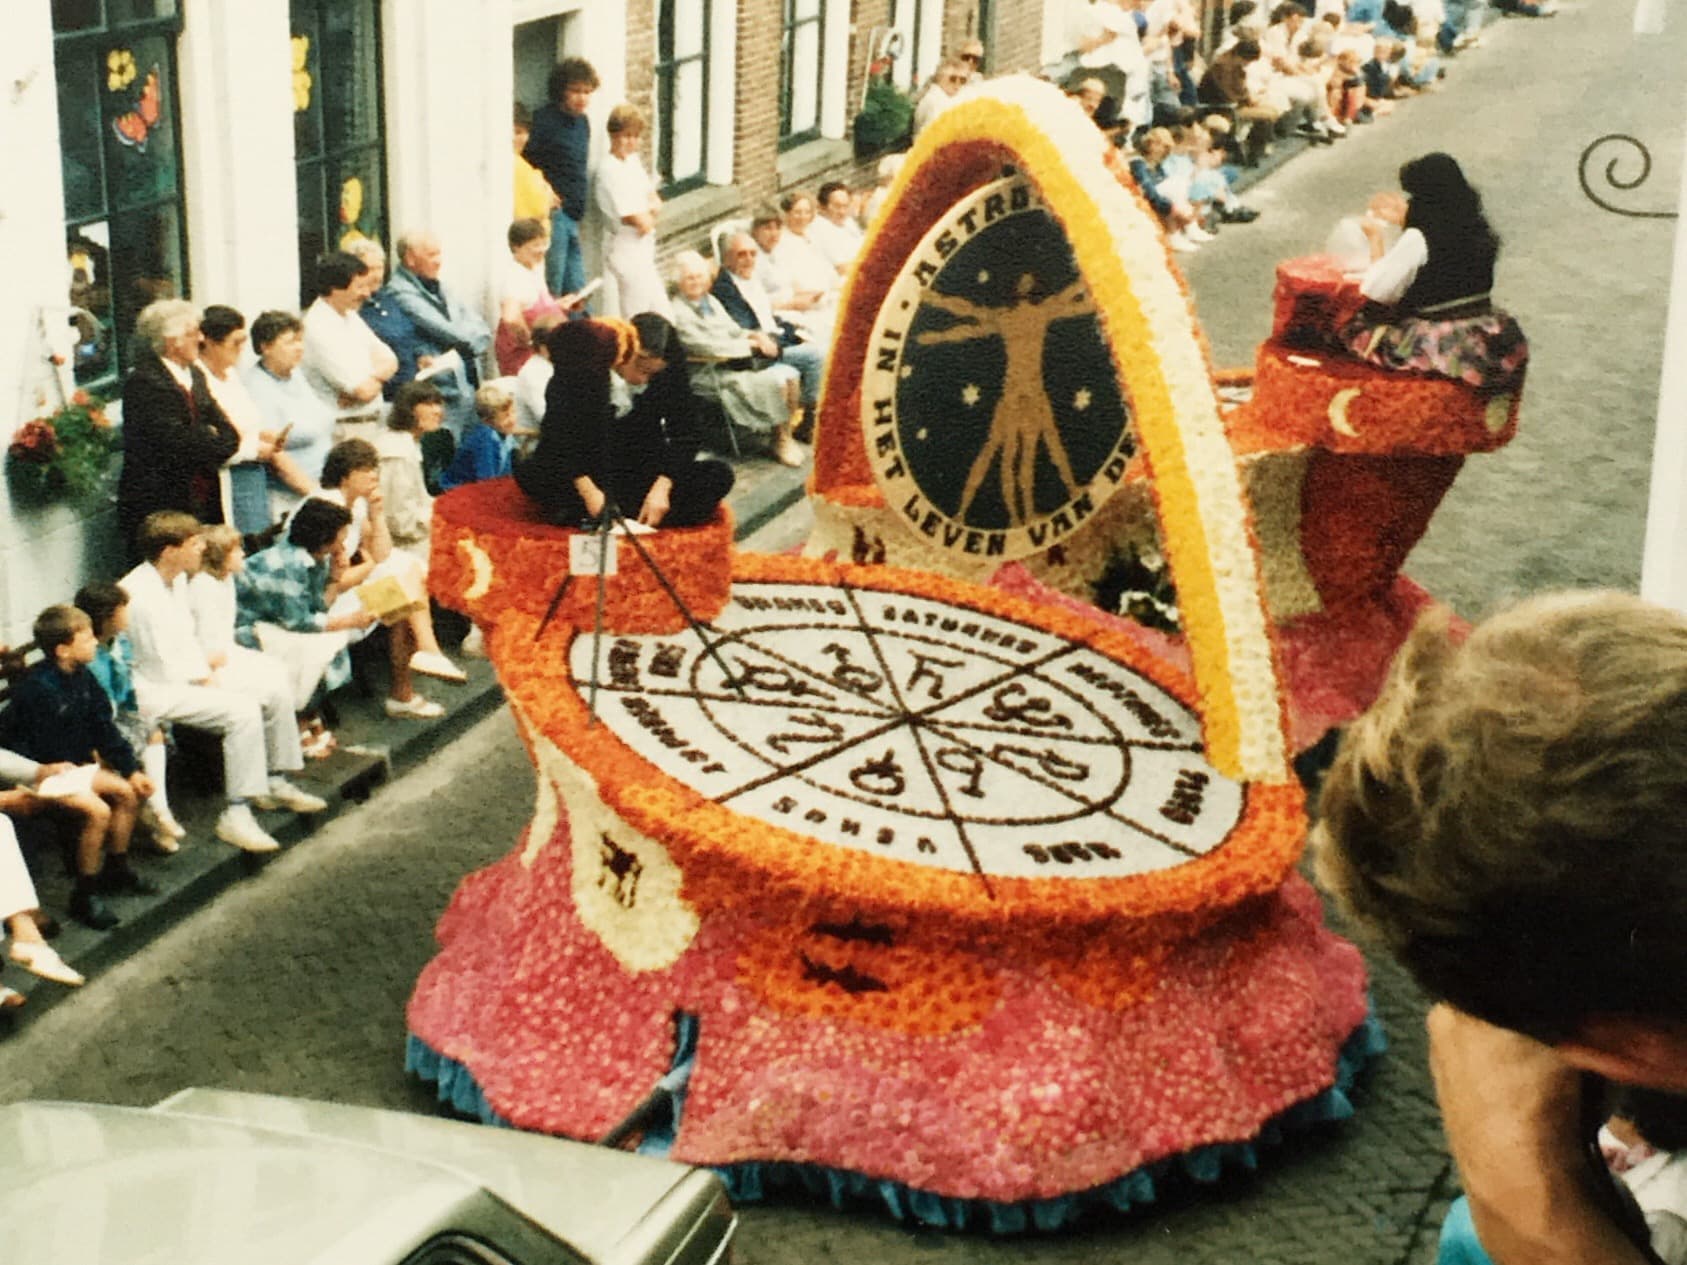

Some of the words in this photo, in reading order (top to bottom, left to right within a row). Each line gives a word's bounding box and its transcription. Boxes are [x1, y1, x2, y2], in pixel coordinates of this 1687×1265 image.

[913, 184, 1043, 287] ASTRO
[876, 329, 902, 372] IN
[873, 400, 905, 480] HET
[903, 494, 1006, 556] LEVEN
[1028, 492, 1093, 544] VAN
[771, 796, 938, 854] VENUS
